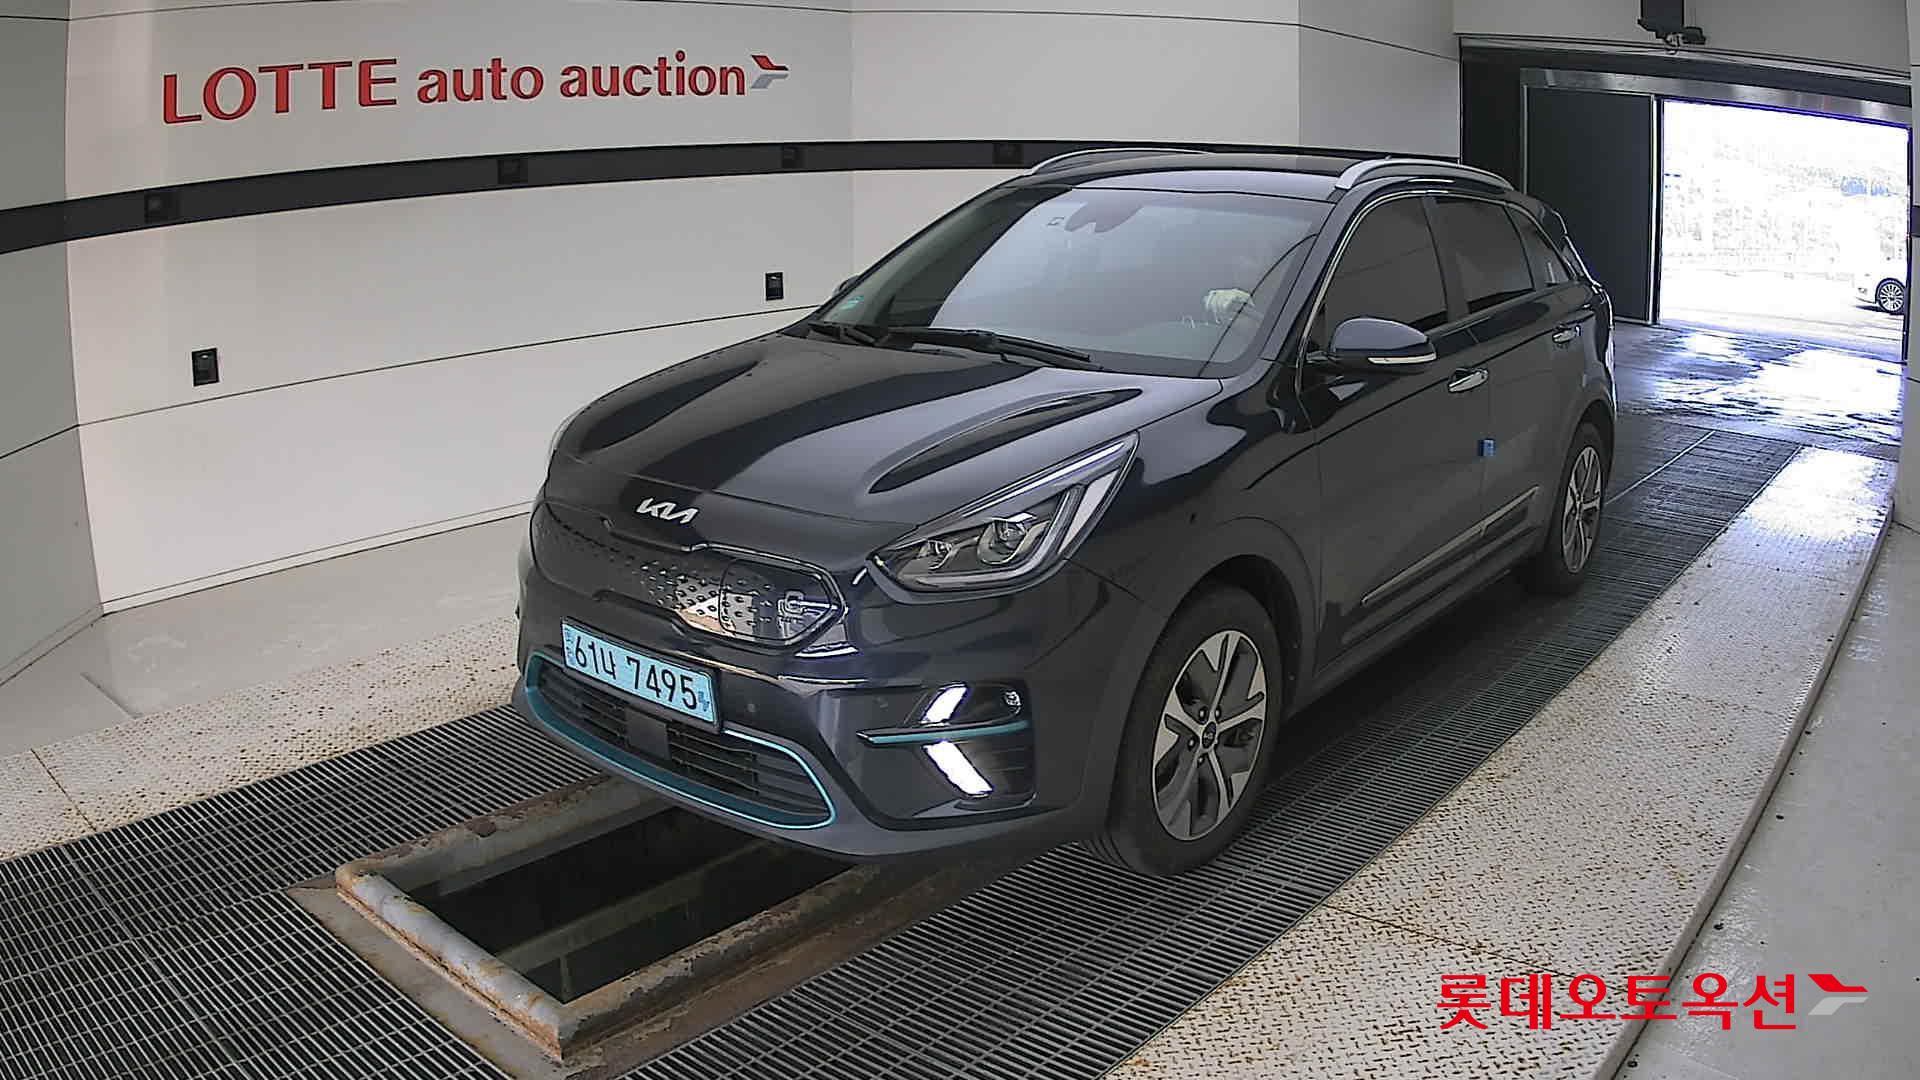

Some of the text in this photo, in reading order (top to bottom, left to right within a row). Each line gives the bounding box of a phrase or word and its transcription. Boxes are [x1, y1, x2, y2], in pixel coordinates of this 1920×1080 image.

[163, 50, 746, 125] LOTTE auto auction
[636, 498, 699, 525] KIA
[626, 655, 697, 710] 7495
